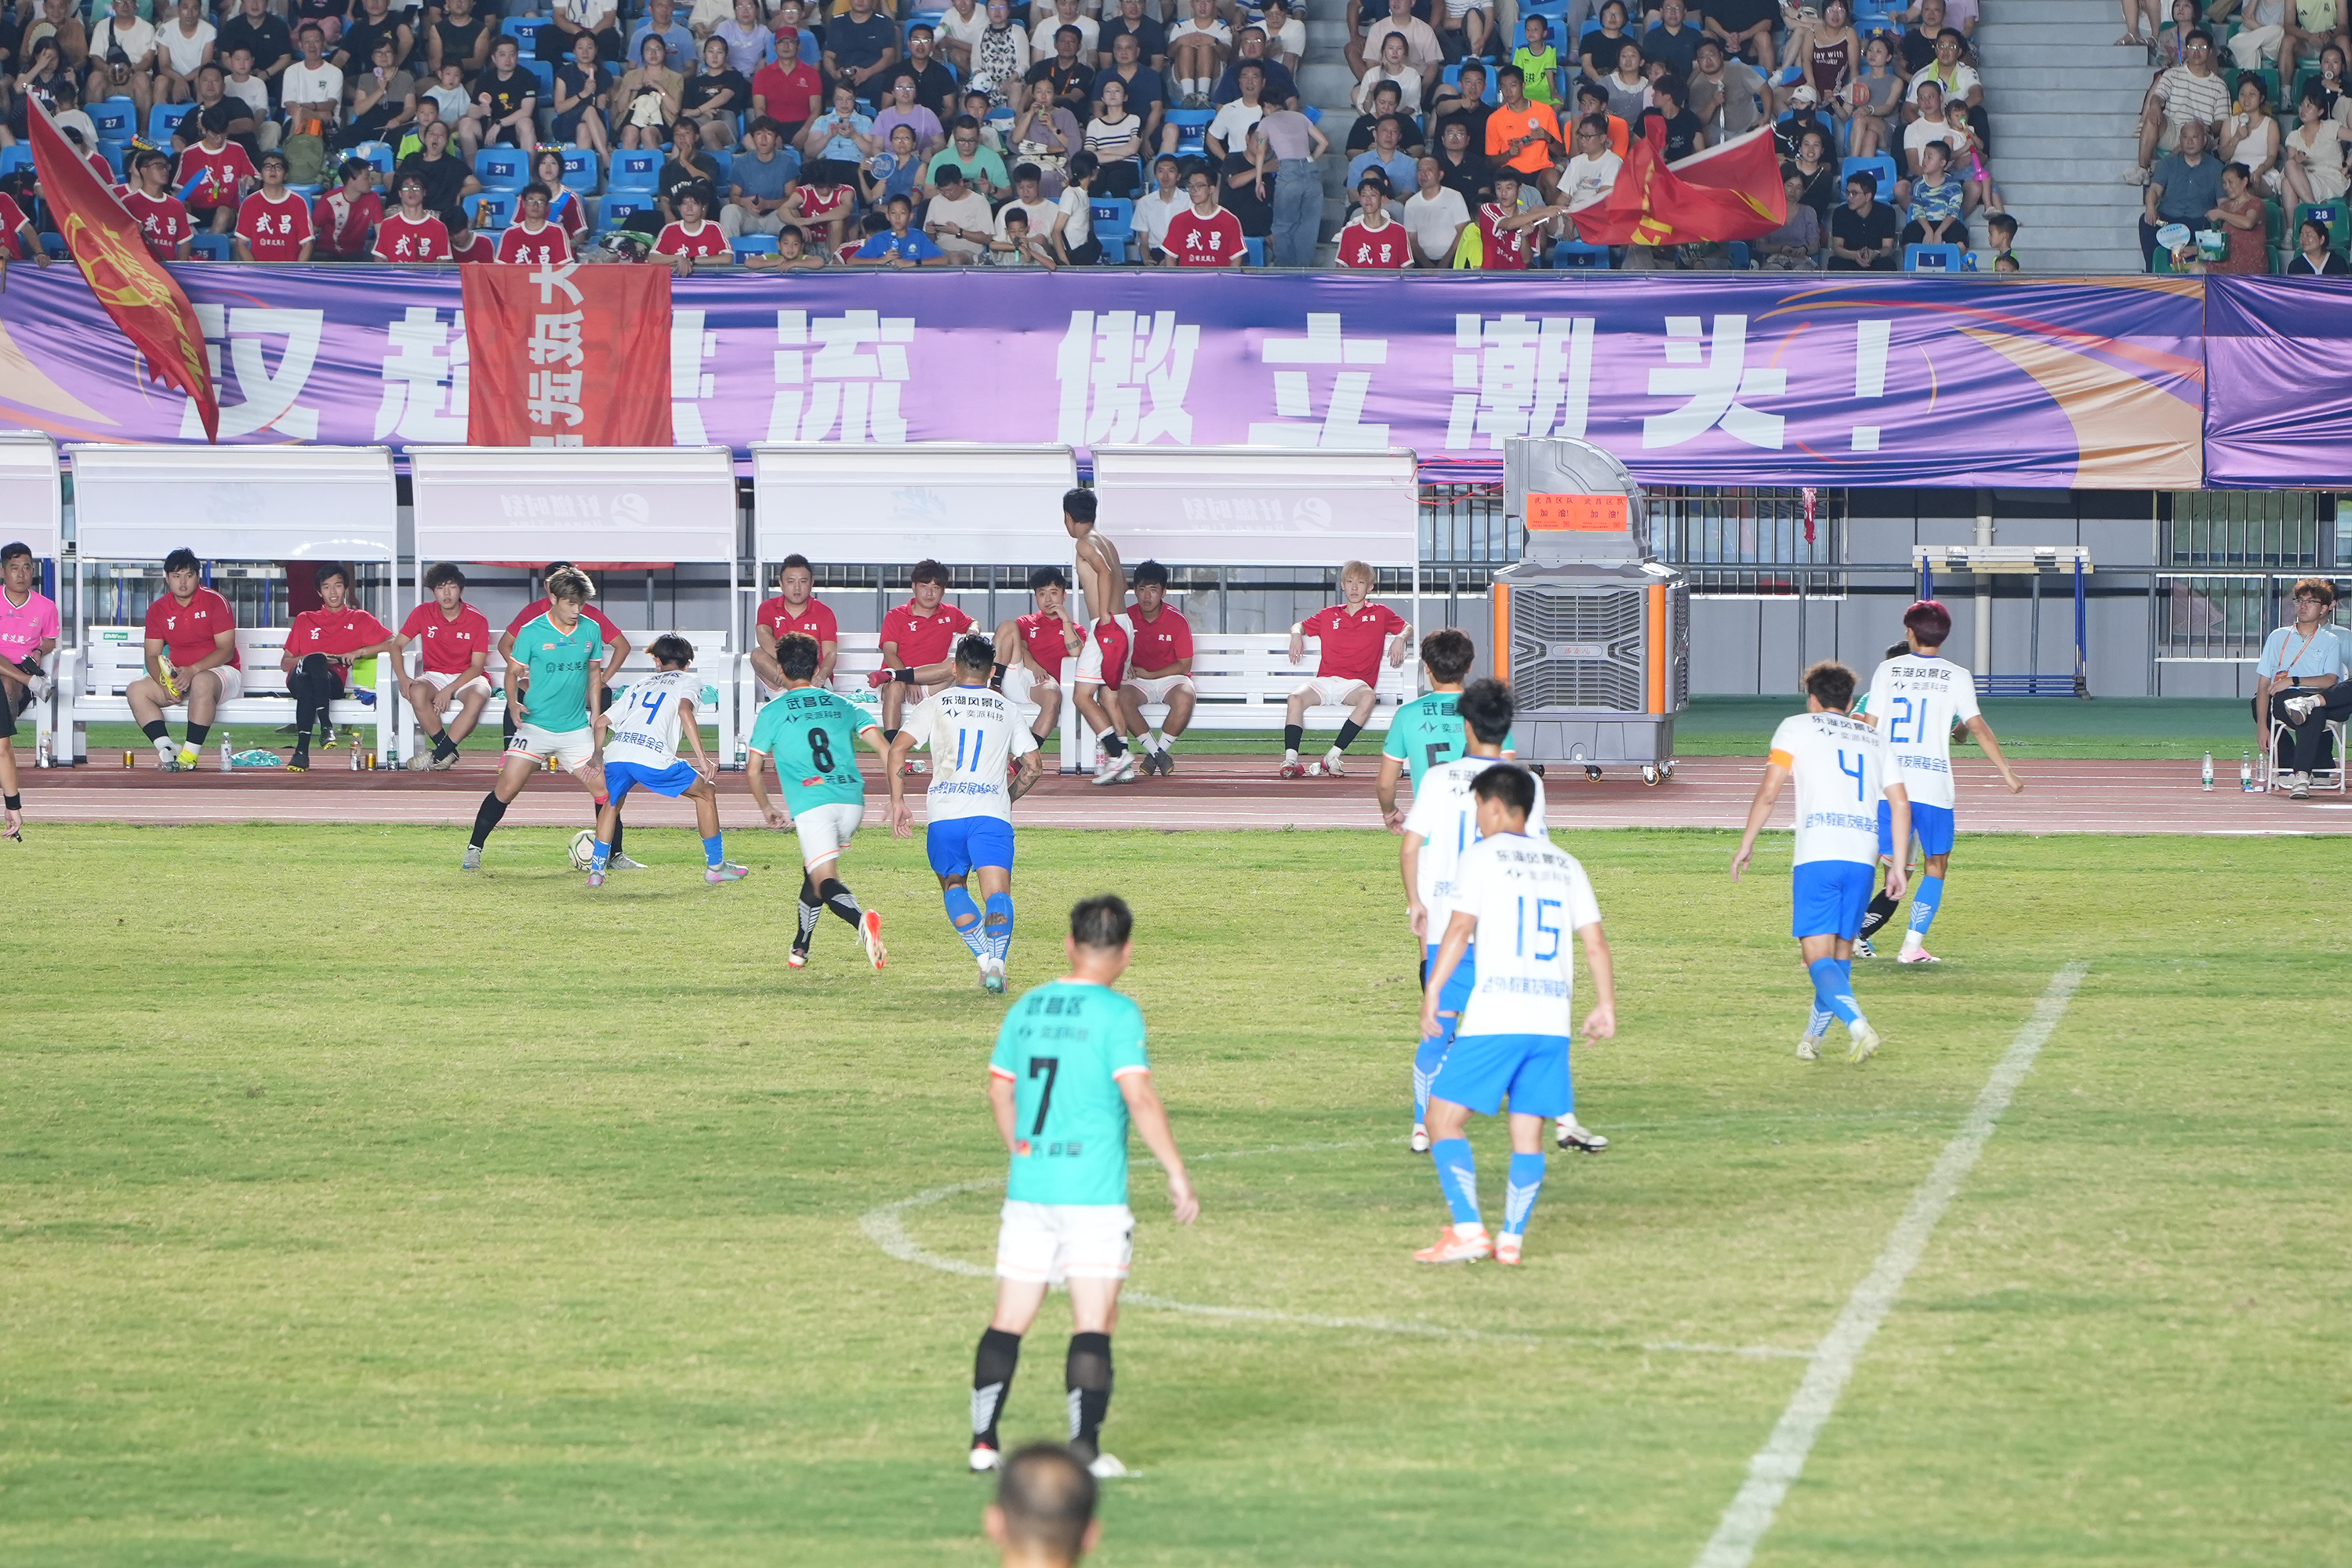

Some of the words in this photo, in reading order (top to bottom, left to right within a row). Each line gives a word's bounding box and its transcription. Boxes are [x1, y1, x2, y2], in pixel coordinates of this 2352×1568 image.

[105, 118, 117, 128] 27
[1185, 126, 1196, 136] 11
[495, 165, 506, 173] 21
[564, 161, 578, 170] 20
[633, 161, 644, 170] 19
[198, 165, 234, 184] 武昌
[619, 206, 630, 216] 19
[1099, 209, 1110, 218] 12
[2315, 210, 2328, 220] 28
[144, 212, 177, 235] 武昌
[256, 212, 292, 234] 武昌
[394, 234, 431, 257] 武昌
[1185, 228, 1221, 251] 武昌
[514, 243, 551, 263] 武昌
[1356, 242, 1392, 264] 武昌
[1929, 256, 1935, 264] 1
[1534, 496, 1573, 505] 武昌区队
[1891, 666, 1953, 681] 东湖风景区
[1911, 682, 1949, 694] 奕派科技
[786, 695, 833, 710] 武昌区
[941, 695, 1004, 711] 东湖风景区
[804, 710, 843, 721] 奕派科技
[966, 709, 1004, 723] 奕派科技
[1890, 697, 1927, 744] 21
[1812, 714, 1878, 736] 东湖风景区
[808, 727, 835, 773] 8
[956, 728, 983, 772] 11
[1838, 749, 1864, 802] 4
[1516, 896, 1561, 961] 15
[1029, 1057, 1059, 1135] 7
